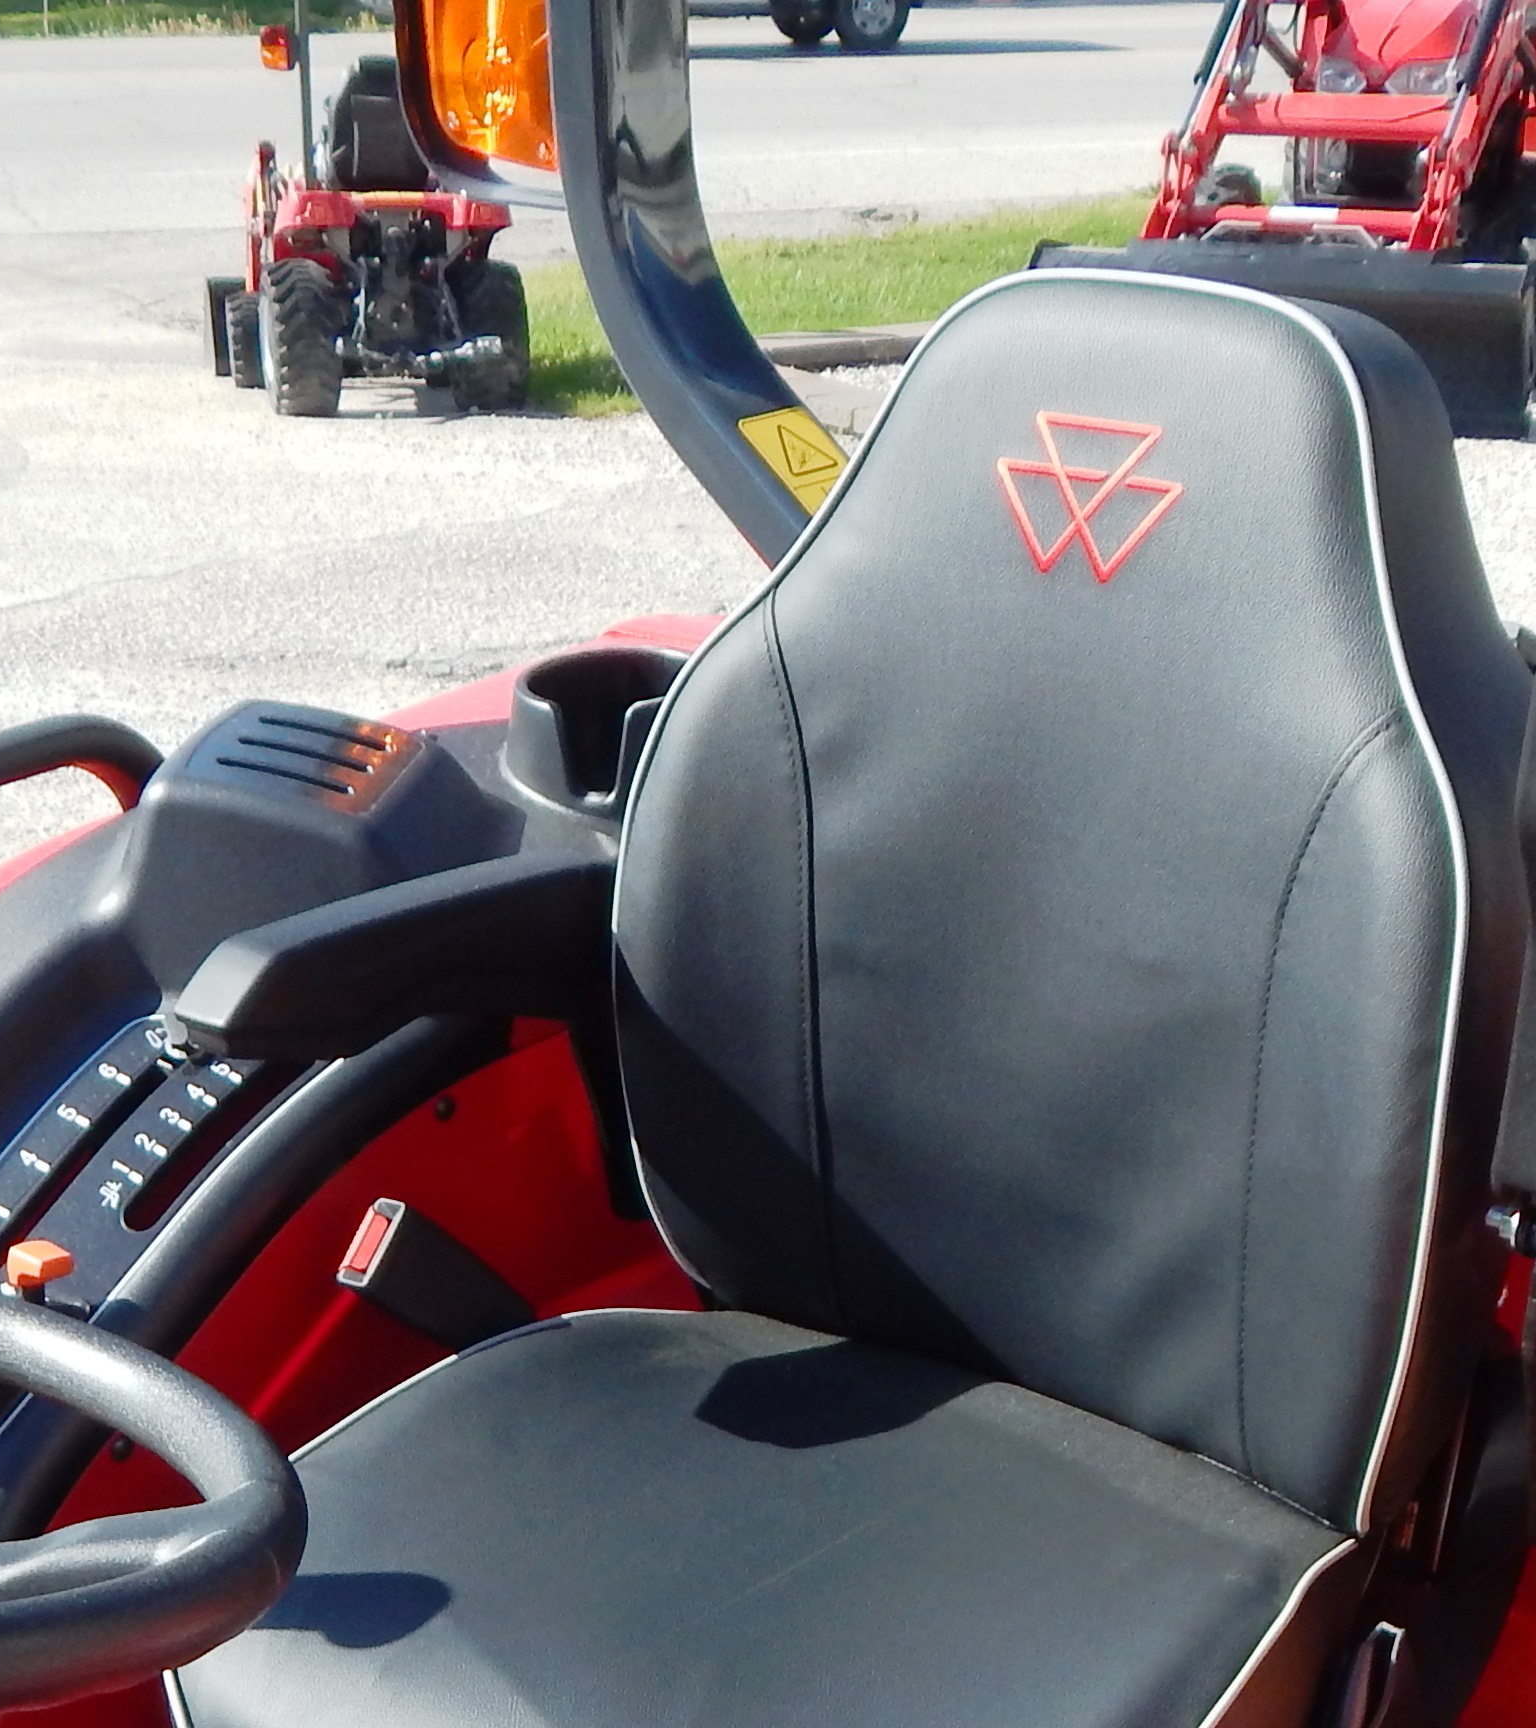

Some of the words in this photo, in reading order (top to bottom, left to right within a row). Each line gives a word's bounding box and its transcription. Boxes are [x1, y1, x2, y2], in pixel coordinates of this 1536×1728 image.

[99, 1062, 118, 1079] 6
[210, 1061, 231, 1076] 5
[187, 1083, 205, 1099] 4
[57, 1103, 77, 1121] 5
[159, 1107, 180, 1126] 3
[135, 1133, 156, 1151] 2
[20, 1149, 37, 1166] 4
[112, 1160, 130, 1173] 1
